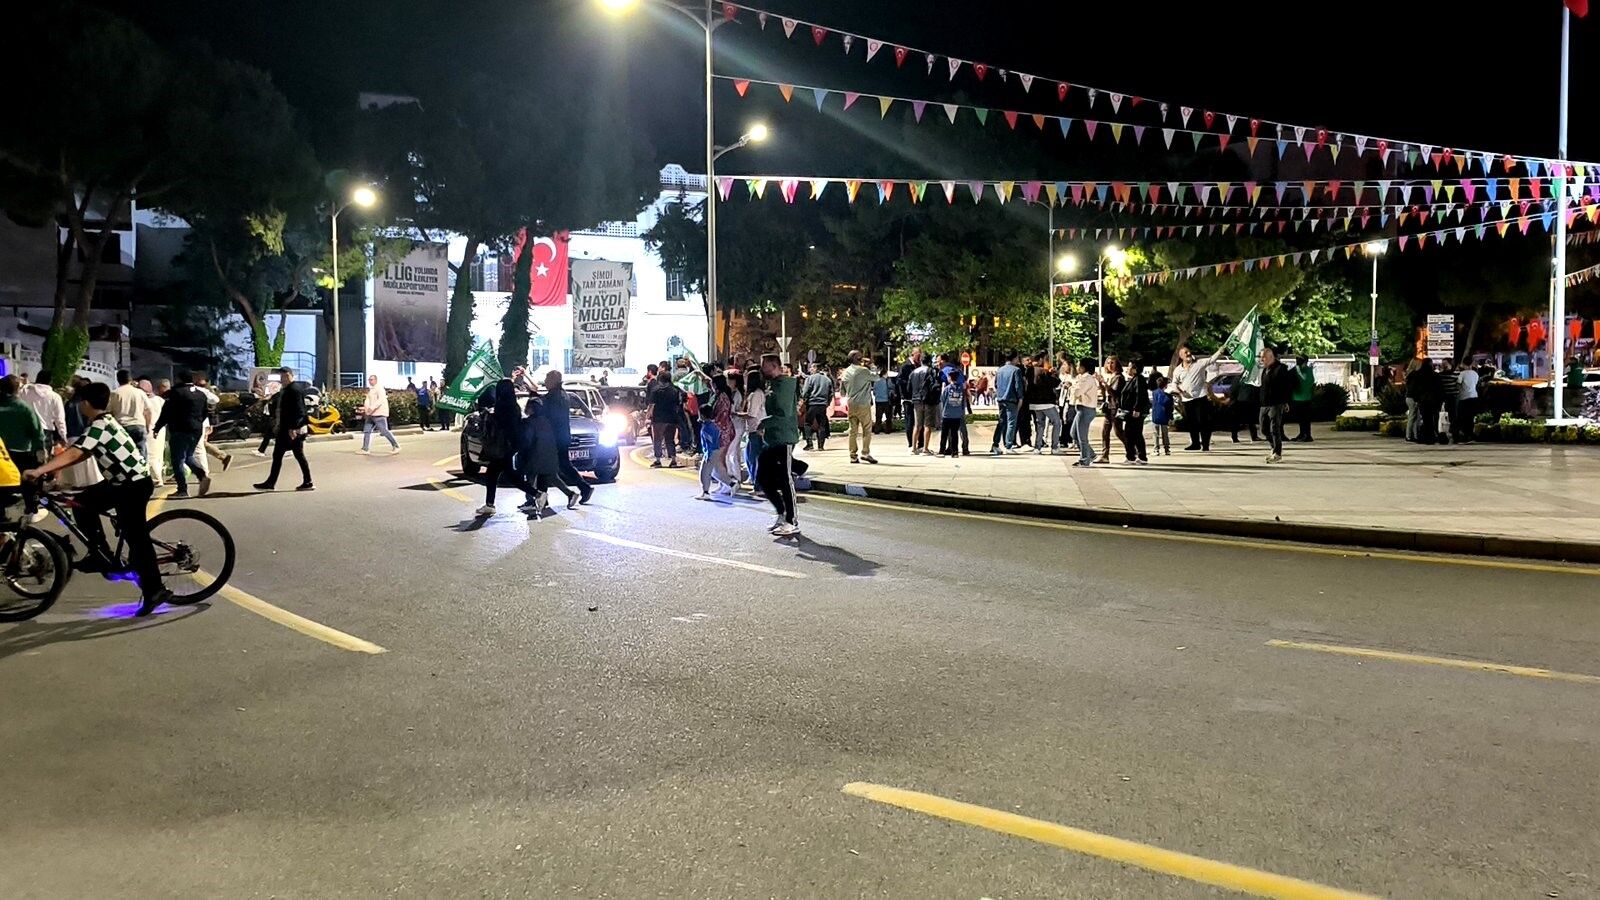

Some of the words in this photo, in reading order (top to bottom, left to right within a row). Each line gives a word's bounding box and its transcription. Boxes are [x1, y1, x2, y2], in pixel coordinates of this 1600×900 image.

[395, 262, 412, 281] LİG
[592, 269, 612, 280] ŞİMDİ
[582, 280, 597, 289] TAM
[598, 279, 624, 289] ZAMANI
[583, 292, 622, 308] HAYDİ
[578, 306, 625, 322] MUĞLA
